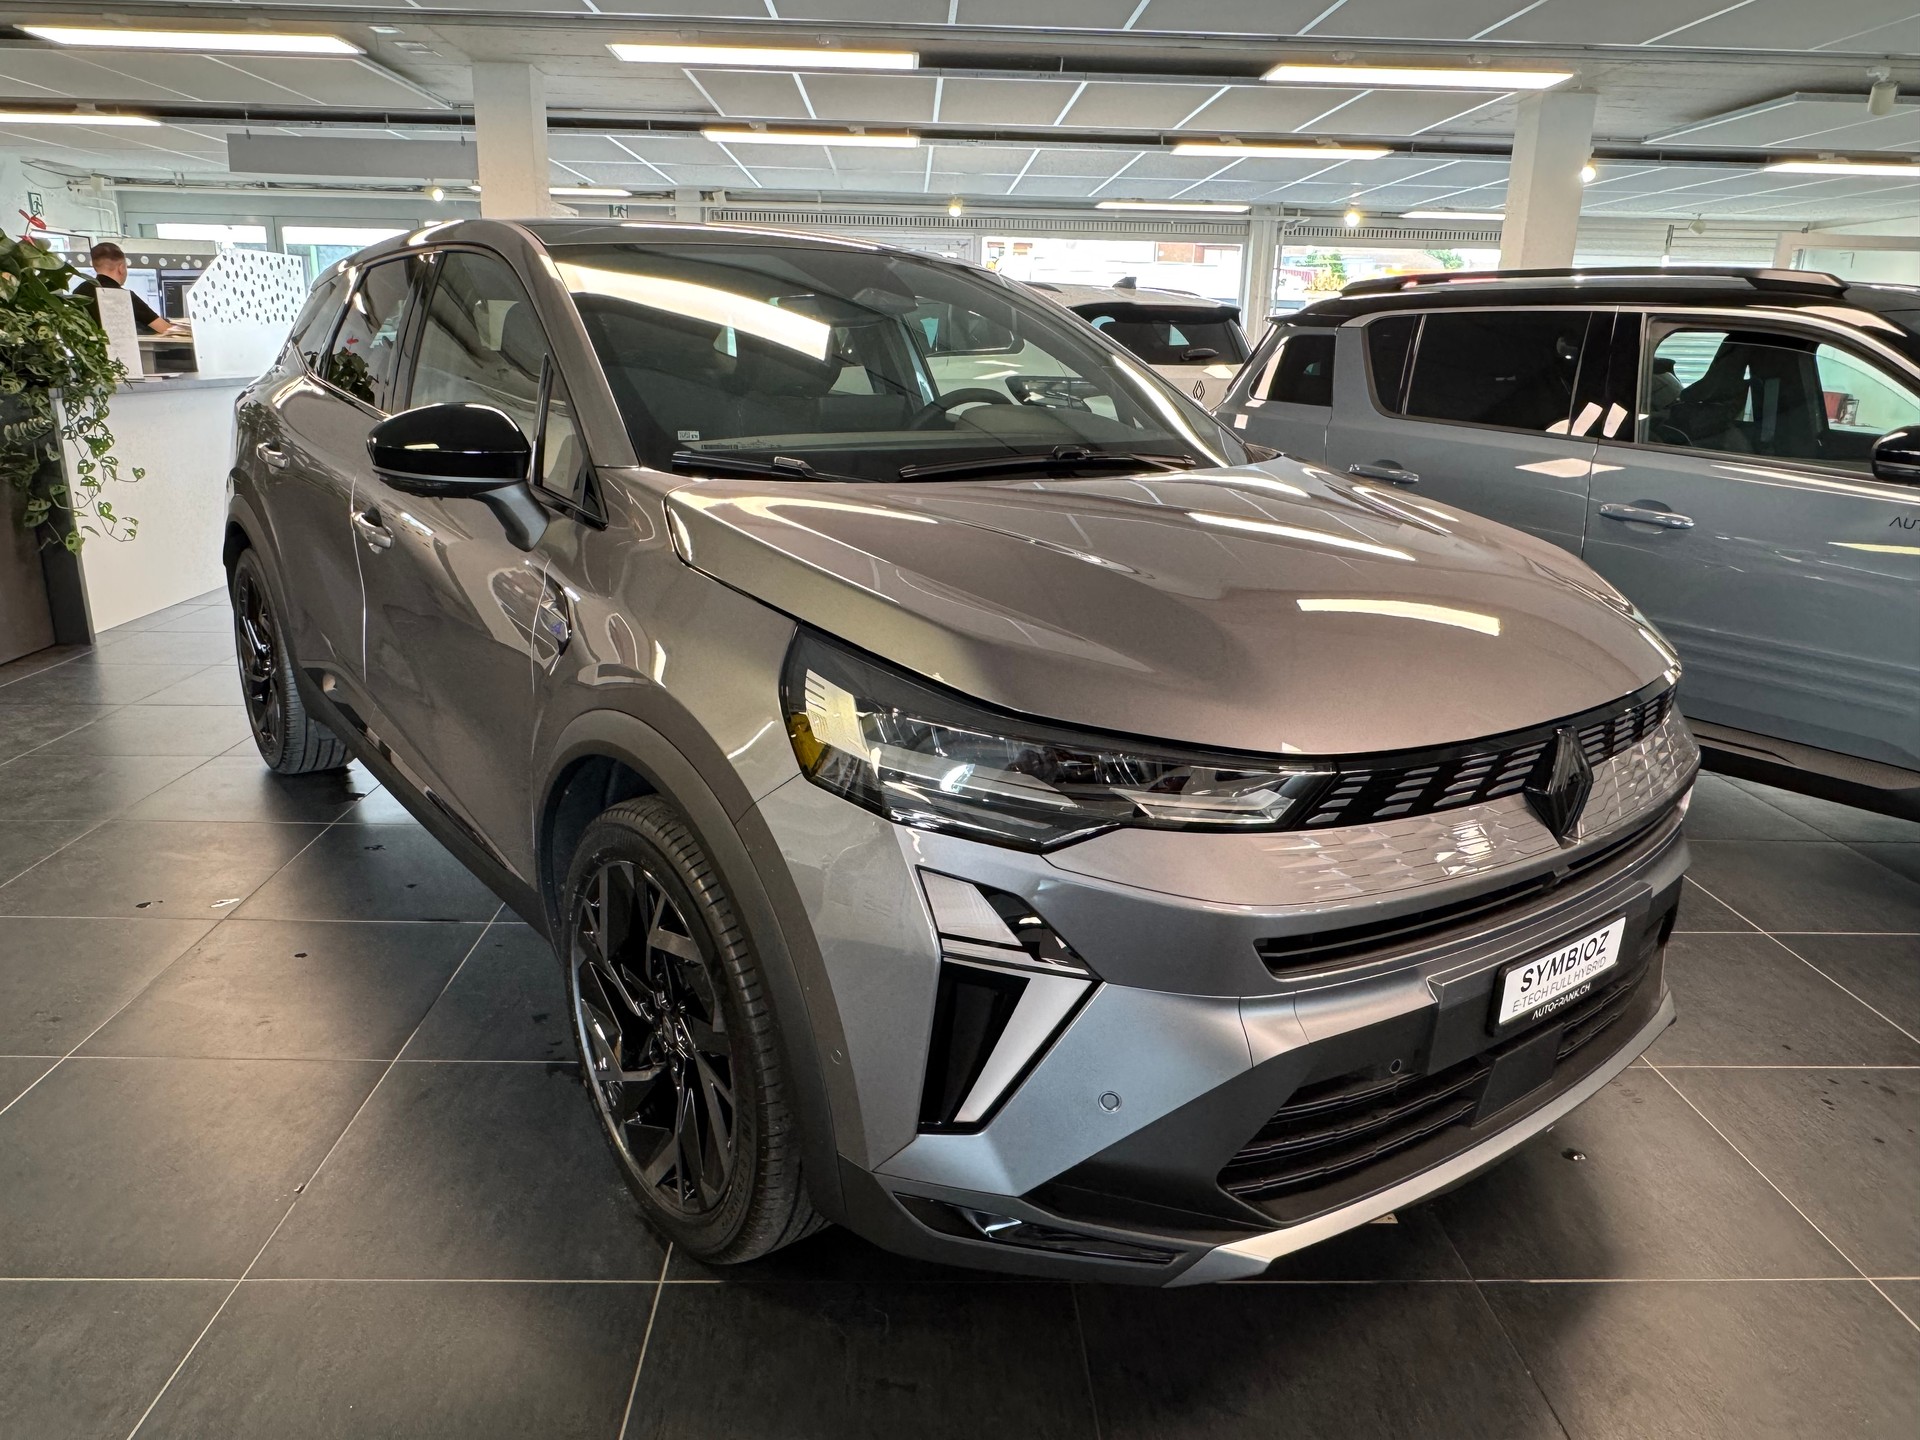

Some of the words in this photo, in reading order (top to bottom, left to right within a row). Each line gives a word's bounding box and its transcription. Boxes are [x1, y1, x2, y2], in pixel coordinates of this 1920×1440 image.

[1512, 985, 1549, 1013] E-TECH
[1549, 975, 1573, 995] FULL
[1573, 956, 1606, 981] HYBRID
[1520, 930, 1609, 993] SYMBIOZ
